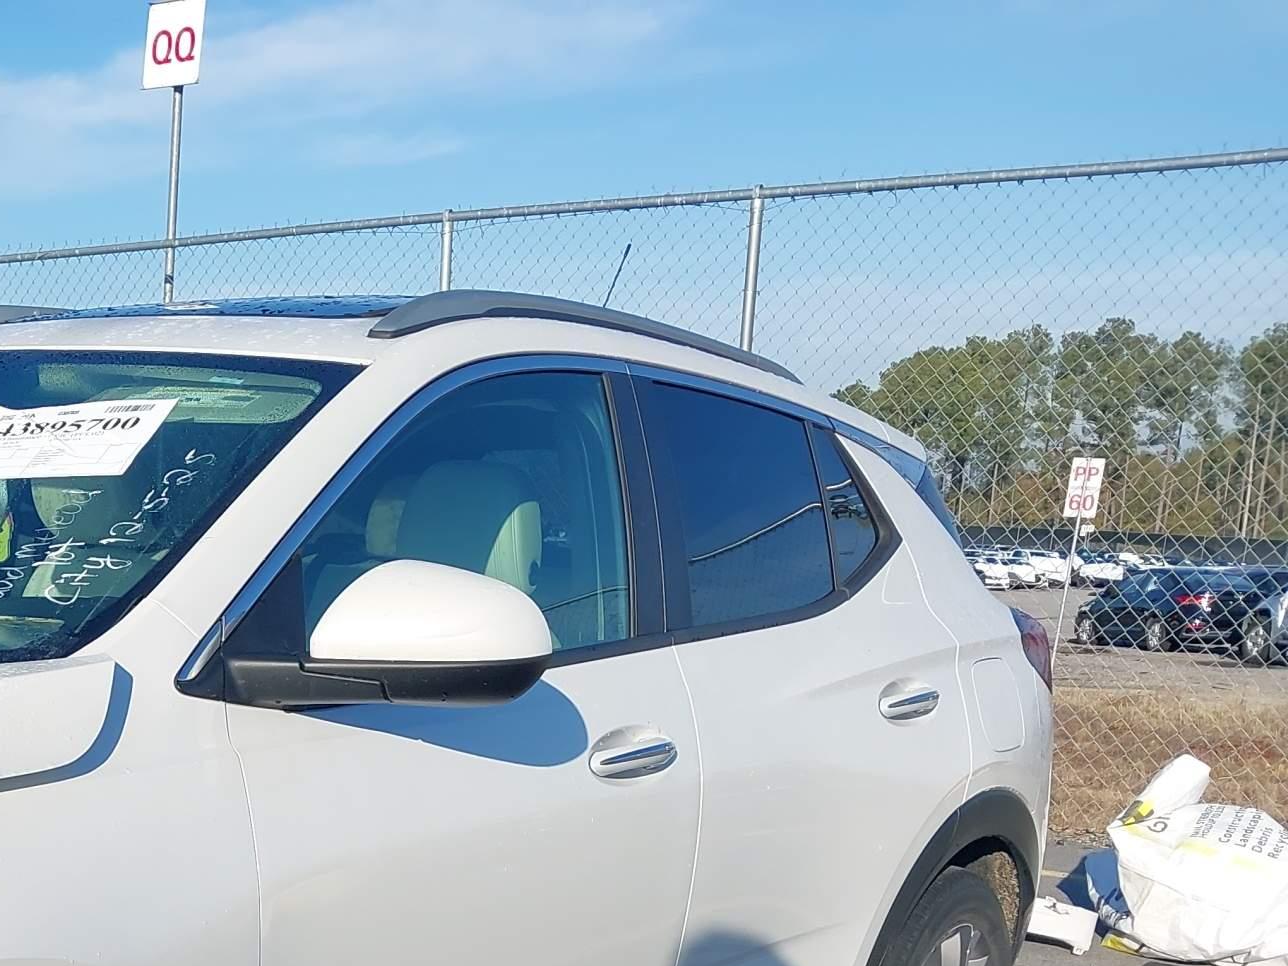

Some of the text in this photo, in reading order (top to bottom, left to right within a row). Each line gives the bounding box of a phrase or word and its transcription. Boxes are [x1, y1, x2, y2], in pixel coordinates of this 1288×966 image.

[152, 26, 195, 65] QQ
[1074, 466, 1099, 481] PP
[1069, 494, 1094, 511] 60
[1251, 827, 1274, 853] Debris
